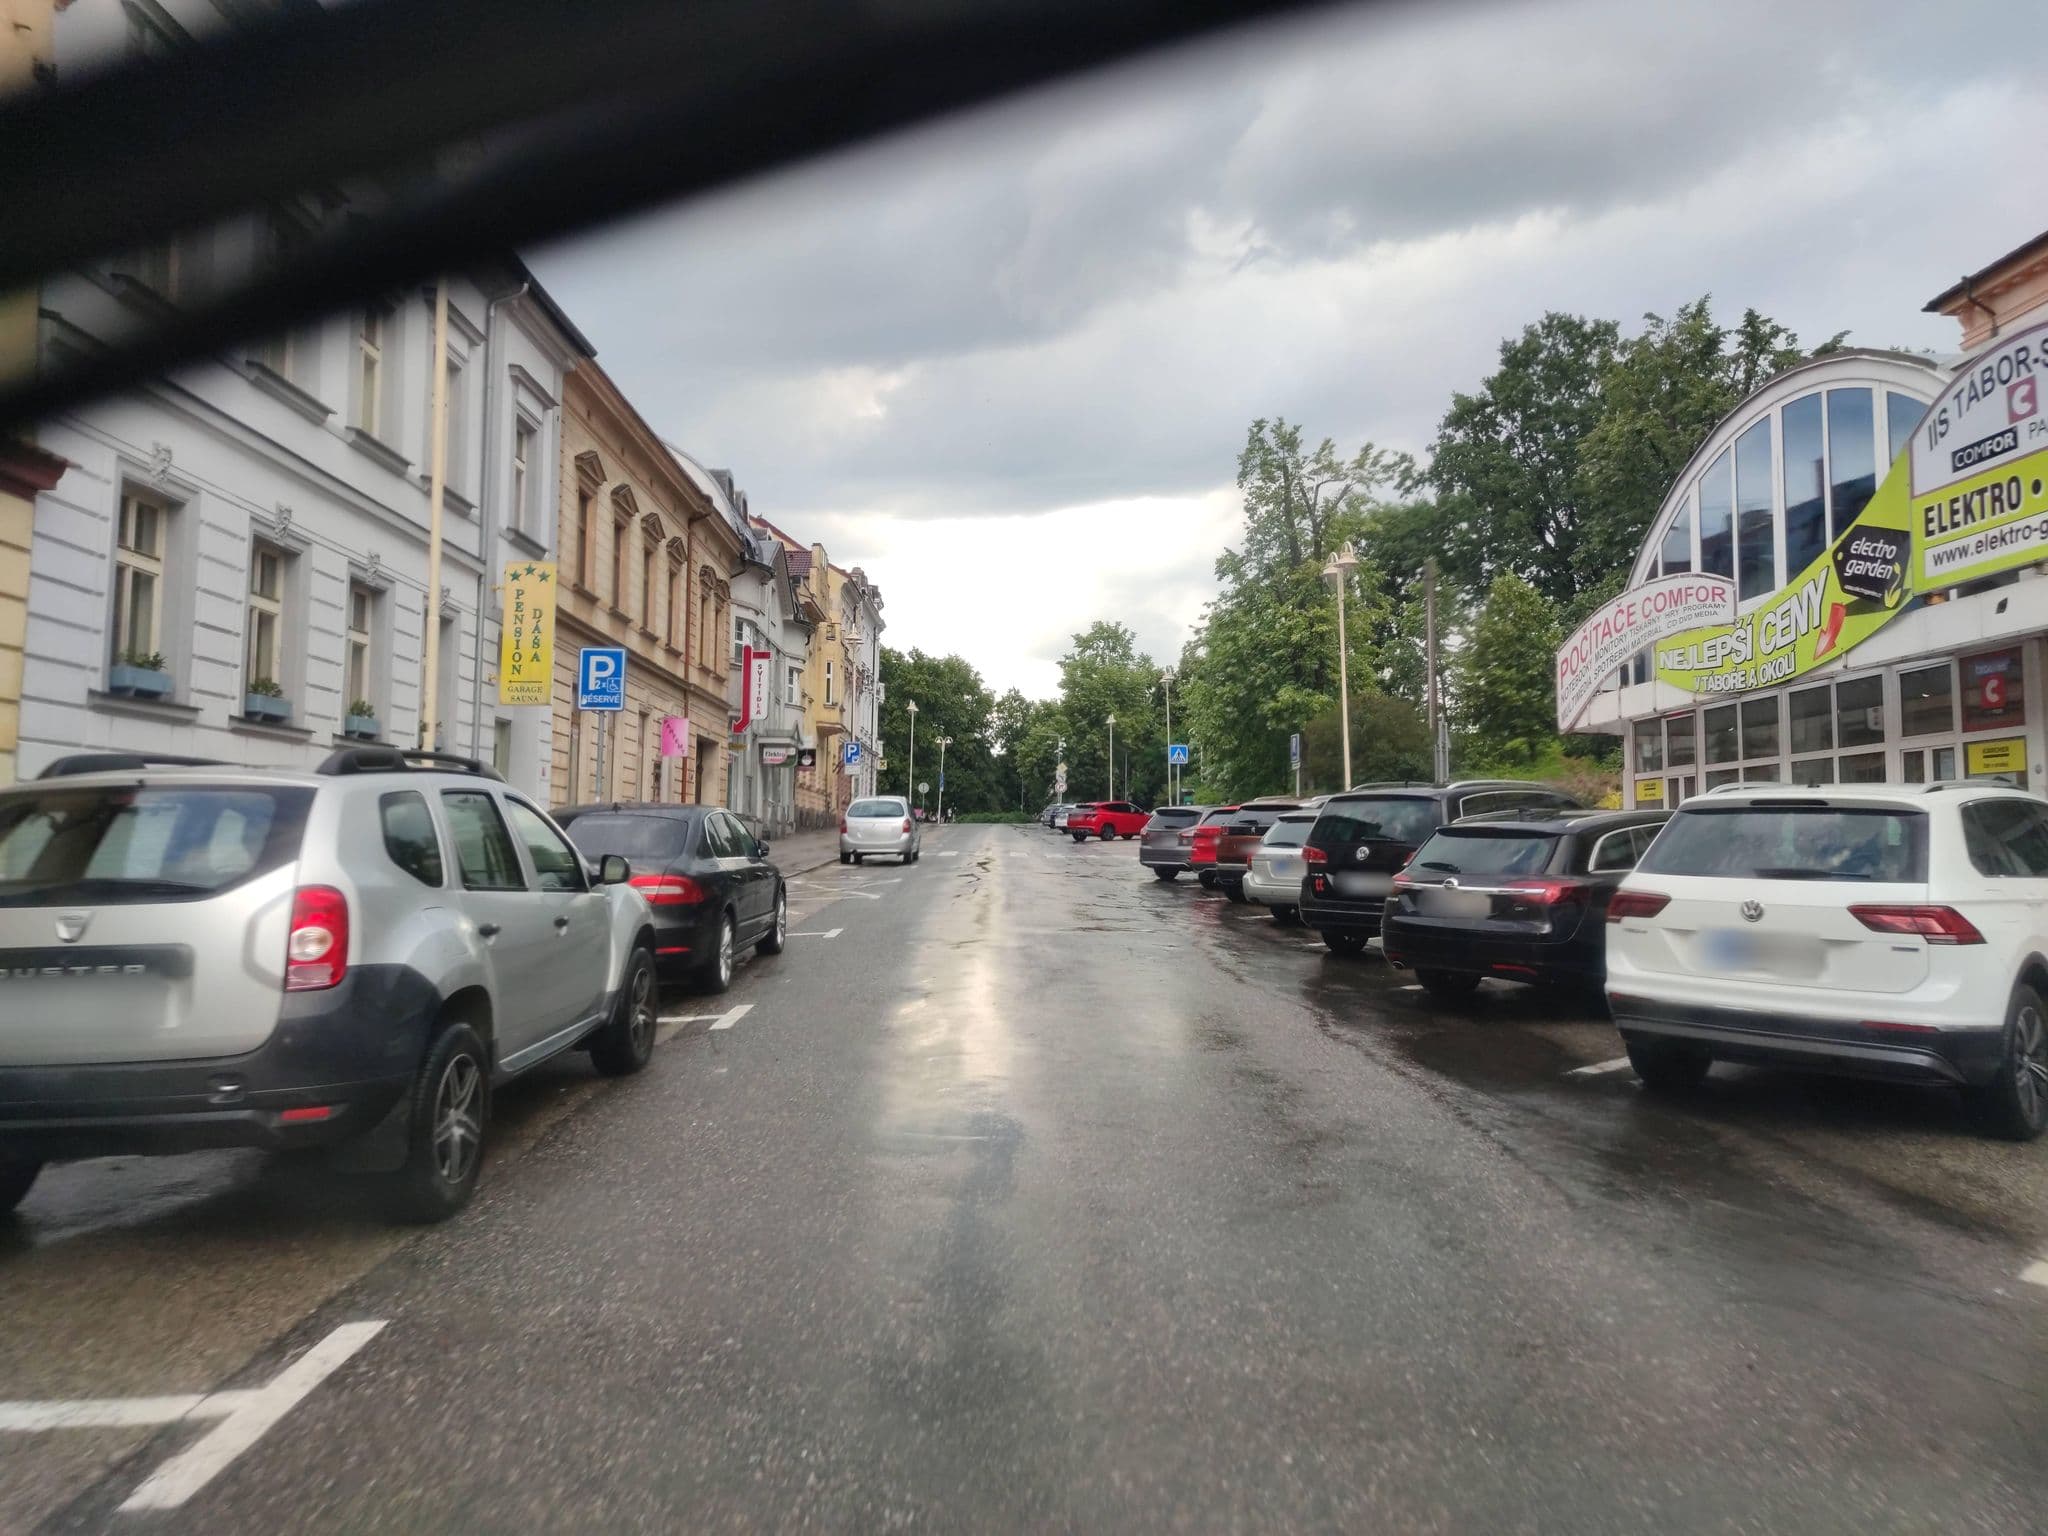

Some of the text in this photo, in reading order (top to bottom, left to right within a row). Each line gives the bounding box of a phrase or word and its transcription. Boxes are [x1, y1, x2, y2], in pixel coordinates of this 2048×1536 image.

[1954, 431, 2015, 469] COMFOR
[1924, 475, 2021, 538] ELEKTRO
[1843, 559, 1893, 579] garden
[1850, 537, 1897, 559] electro
[511, 589, 525, 675] PENSION
[530, 608, 543, 662] DÁŠA
[1560, 585, 1727, 688] POČÍTAČE COMFOR
[1659, 565, 1829, 671] NEJLEPŠÍ CENY
[588, 655, 616, 691] P
[1749, 671, 1759, 689] A
[1760, 644, 1796, 685] OKOLÍ
[508, 685, 543, 694] GARAGE
